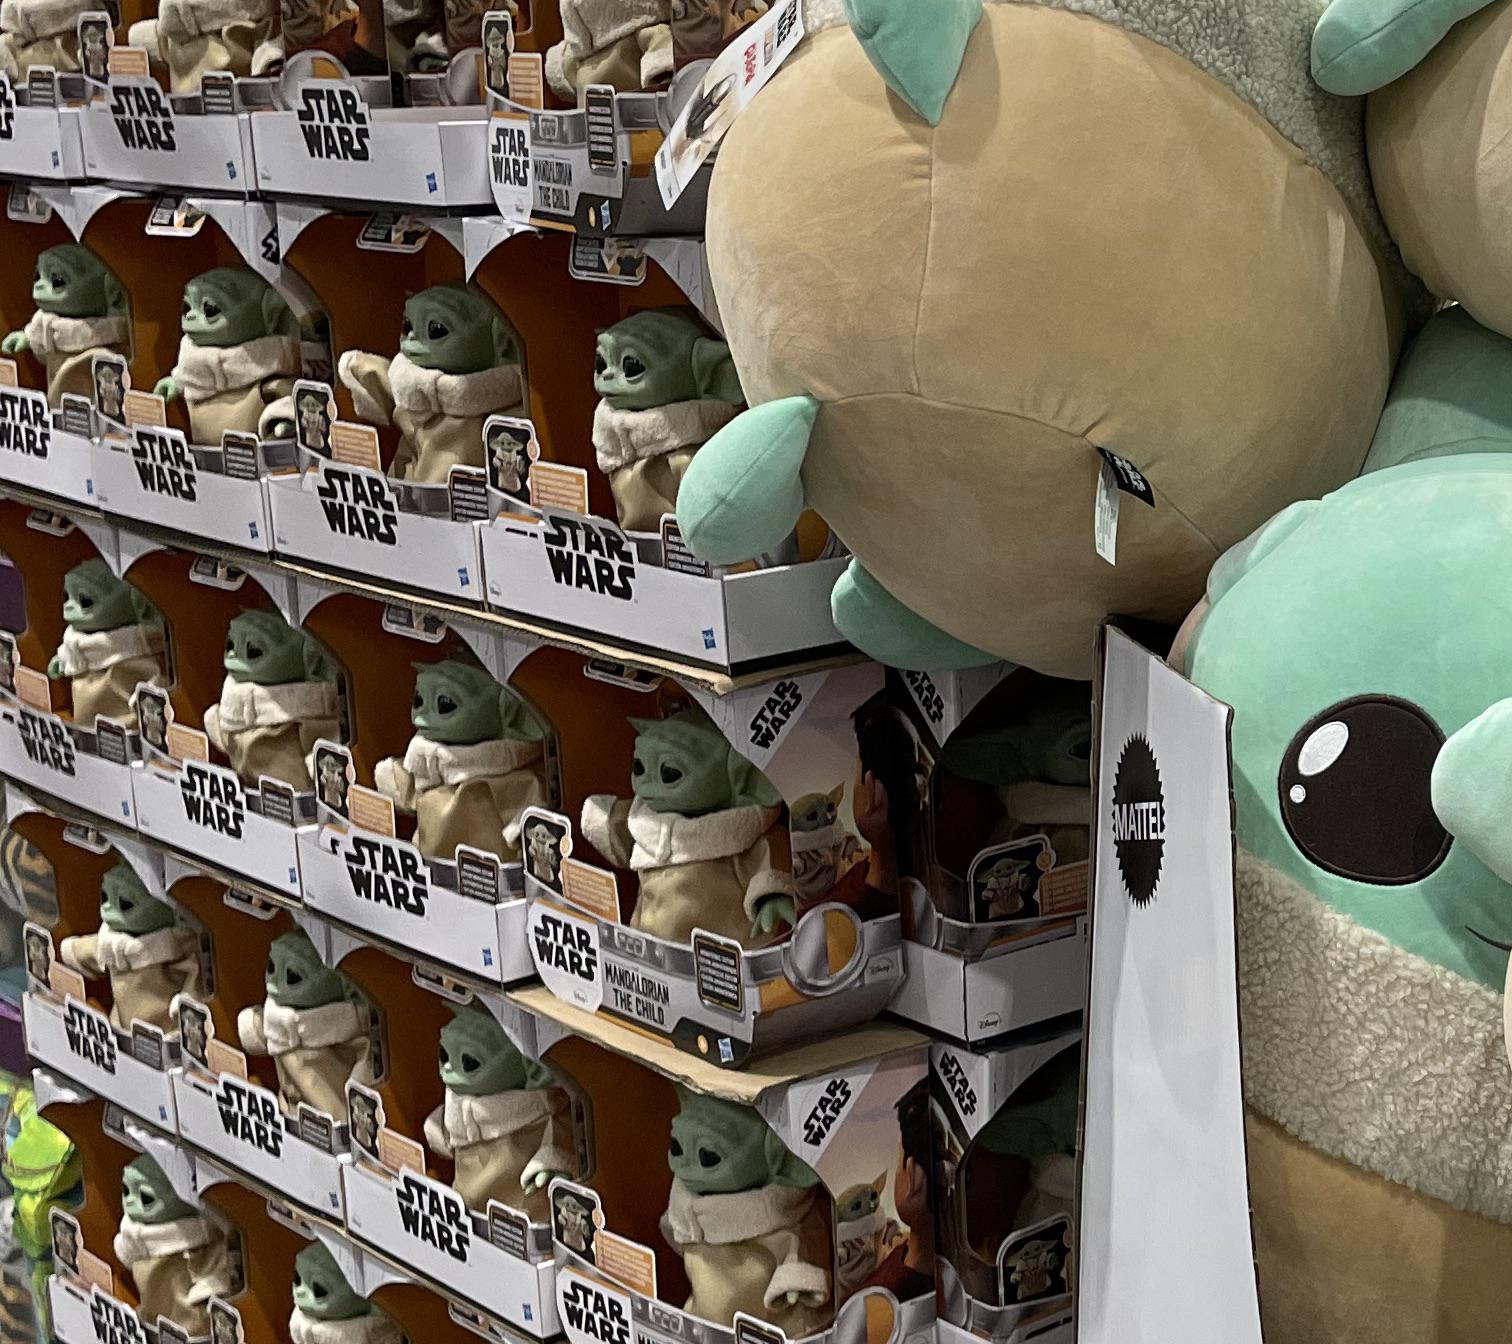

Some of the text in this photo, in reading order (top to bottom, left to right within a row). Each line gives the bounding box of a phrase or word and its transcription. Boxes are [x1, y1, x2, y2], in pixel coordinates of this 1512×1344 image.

[111, 84, 174, 117] STAR
[297, 89, 366, 124] STAR
[112, 117, 176, 151] WARS
[300, 123, 370, 161] WARS
[492, 127, 529, 158] STAR
[492, 156, 529, 187] WARS
[0, 394, 50, 429] STAR
[0, 421, 50, 460] WARS
[132, 430, 193, 471] STAR
[134, 460, 197, 502] WARS
[316, 466, 392, 510] STAR
[320, 500, 398, 546] WARS
[544, 512, 632, 564] STAR
[547, 548, 635, 601] WARS
[17, 708, 71, 749] STAR
[750, 680, 798, 732] STAR
[750, 687, 802, 749] WARS
[21, 733, 76, 777] WARS
[180, 765, 244, 807] STAR
[183, 793, 245, 839] WARS
[1114, 801, 1164, 841] MATTEL
[345, 836, 426, 885] STAR
[347, 868, 429, 917] WARS
[534, 914, 597, 954] STAR
[534, 937, 598, 982] WARS
[64, 1001, 113, 1053] STAR
[613, 987, 667, 1026] THE CHILD
[66, 1026, 117, 1075] WARS
[938, 1056, 975, 1117] WARS
[939, 1051, 978, 1106] STAR
[216, 1082, 281, 1128] STAR
[803, 1078, 846, 1136] STAR
[804, 1085, 852, 1148] WARS
[218, 1106, 283, 1156] WARS
[397, 1175, 468, 1232] STAR
[399, 1205, 470, 1262] WARS
[90, 1291, 144, 1344] STAR
[564, 1281, 628, 1327] STAR
